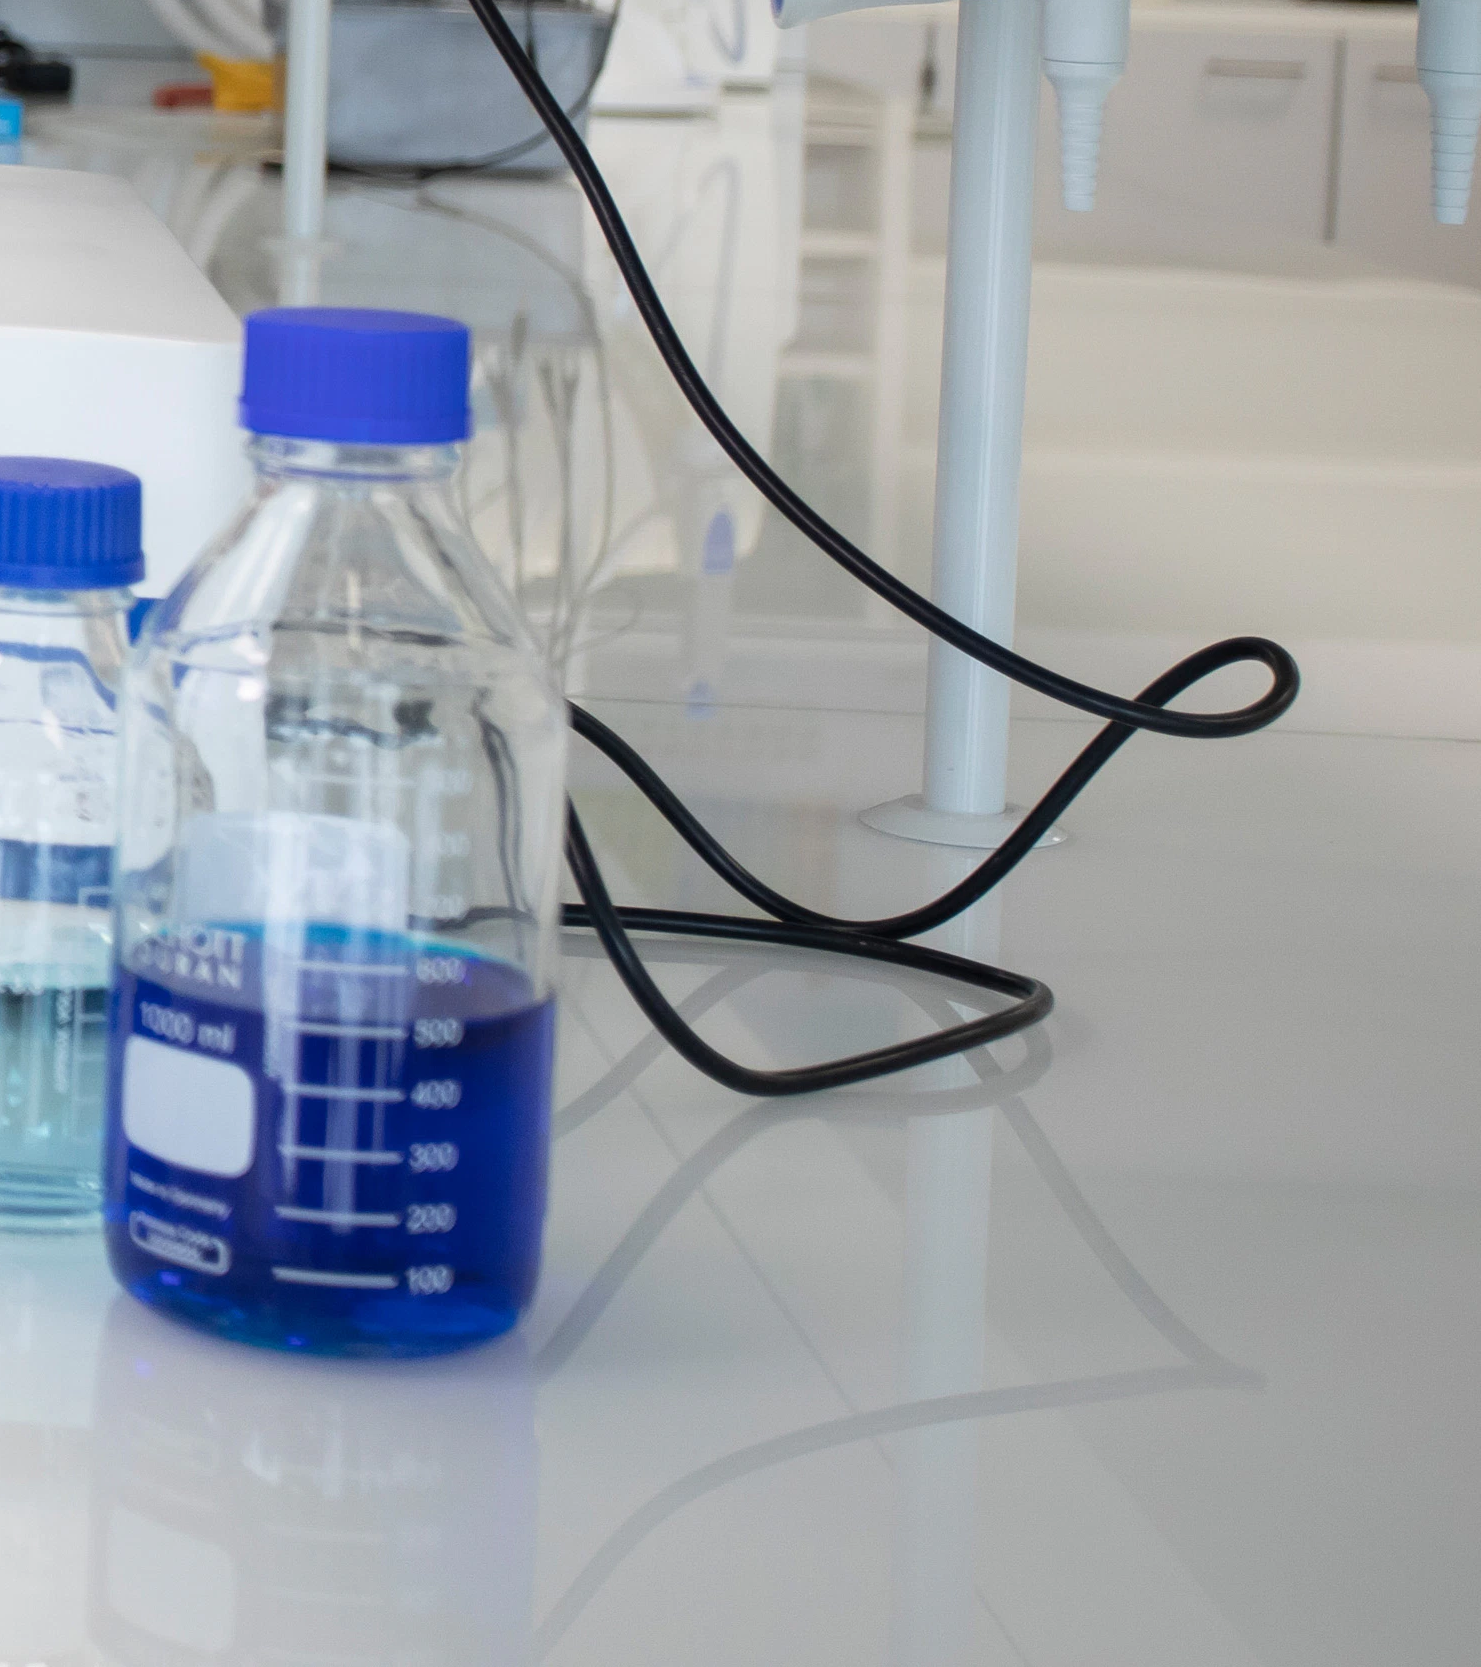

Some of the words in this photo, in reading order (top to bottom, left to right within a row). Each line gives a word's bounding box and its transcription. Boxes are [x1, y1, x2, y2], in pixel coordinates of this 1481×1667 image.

[139, 1000, 195, 1046] 1000
[197, 1021, 237, 1054] ml
[413, 1017, 465, 1048] 500
[410, 1079, 462, 1109] 400
[408, 1142, 460, 1173] 300
[406, 1203, 458, 1234] 200
[404, 1264, 455, 1296] 100
